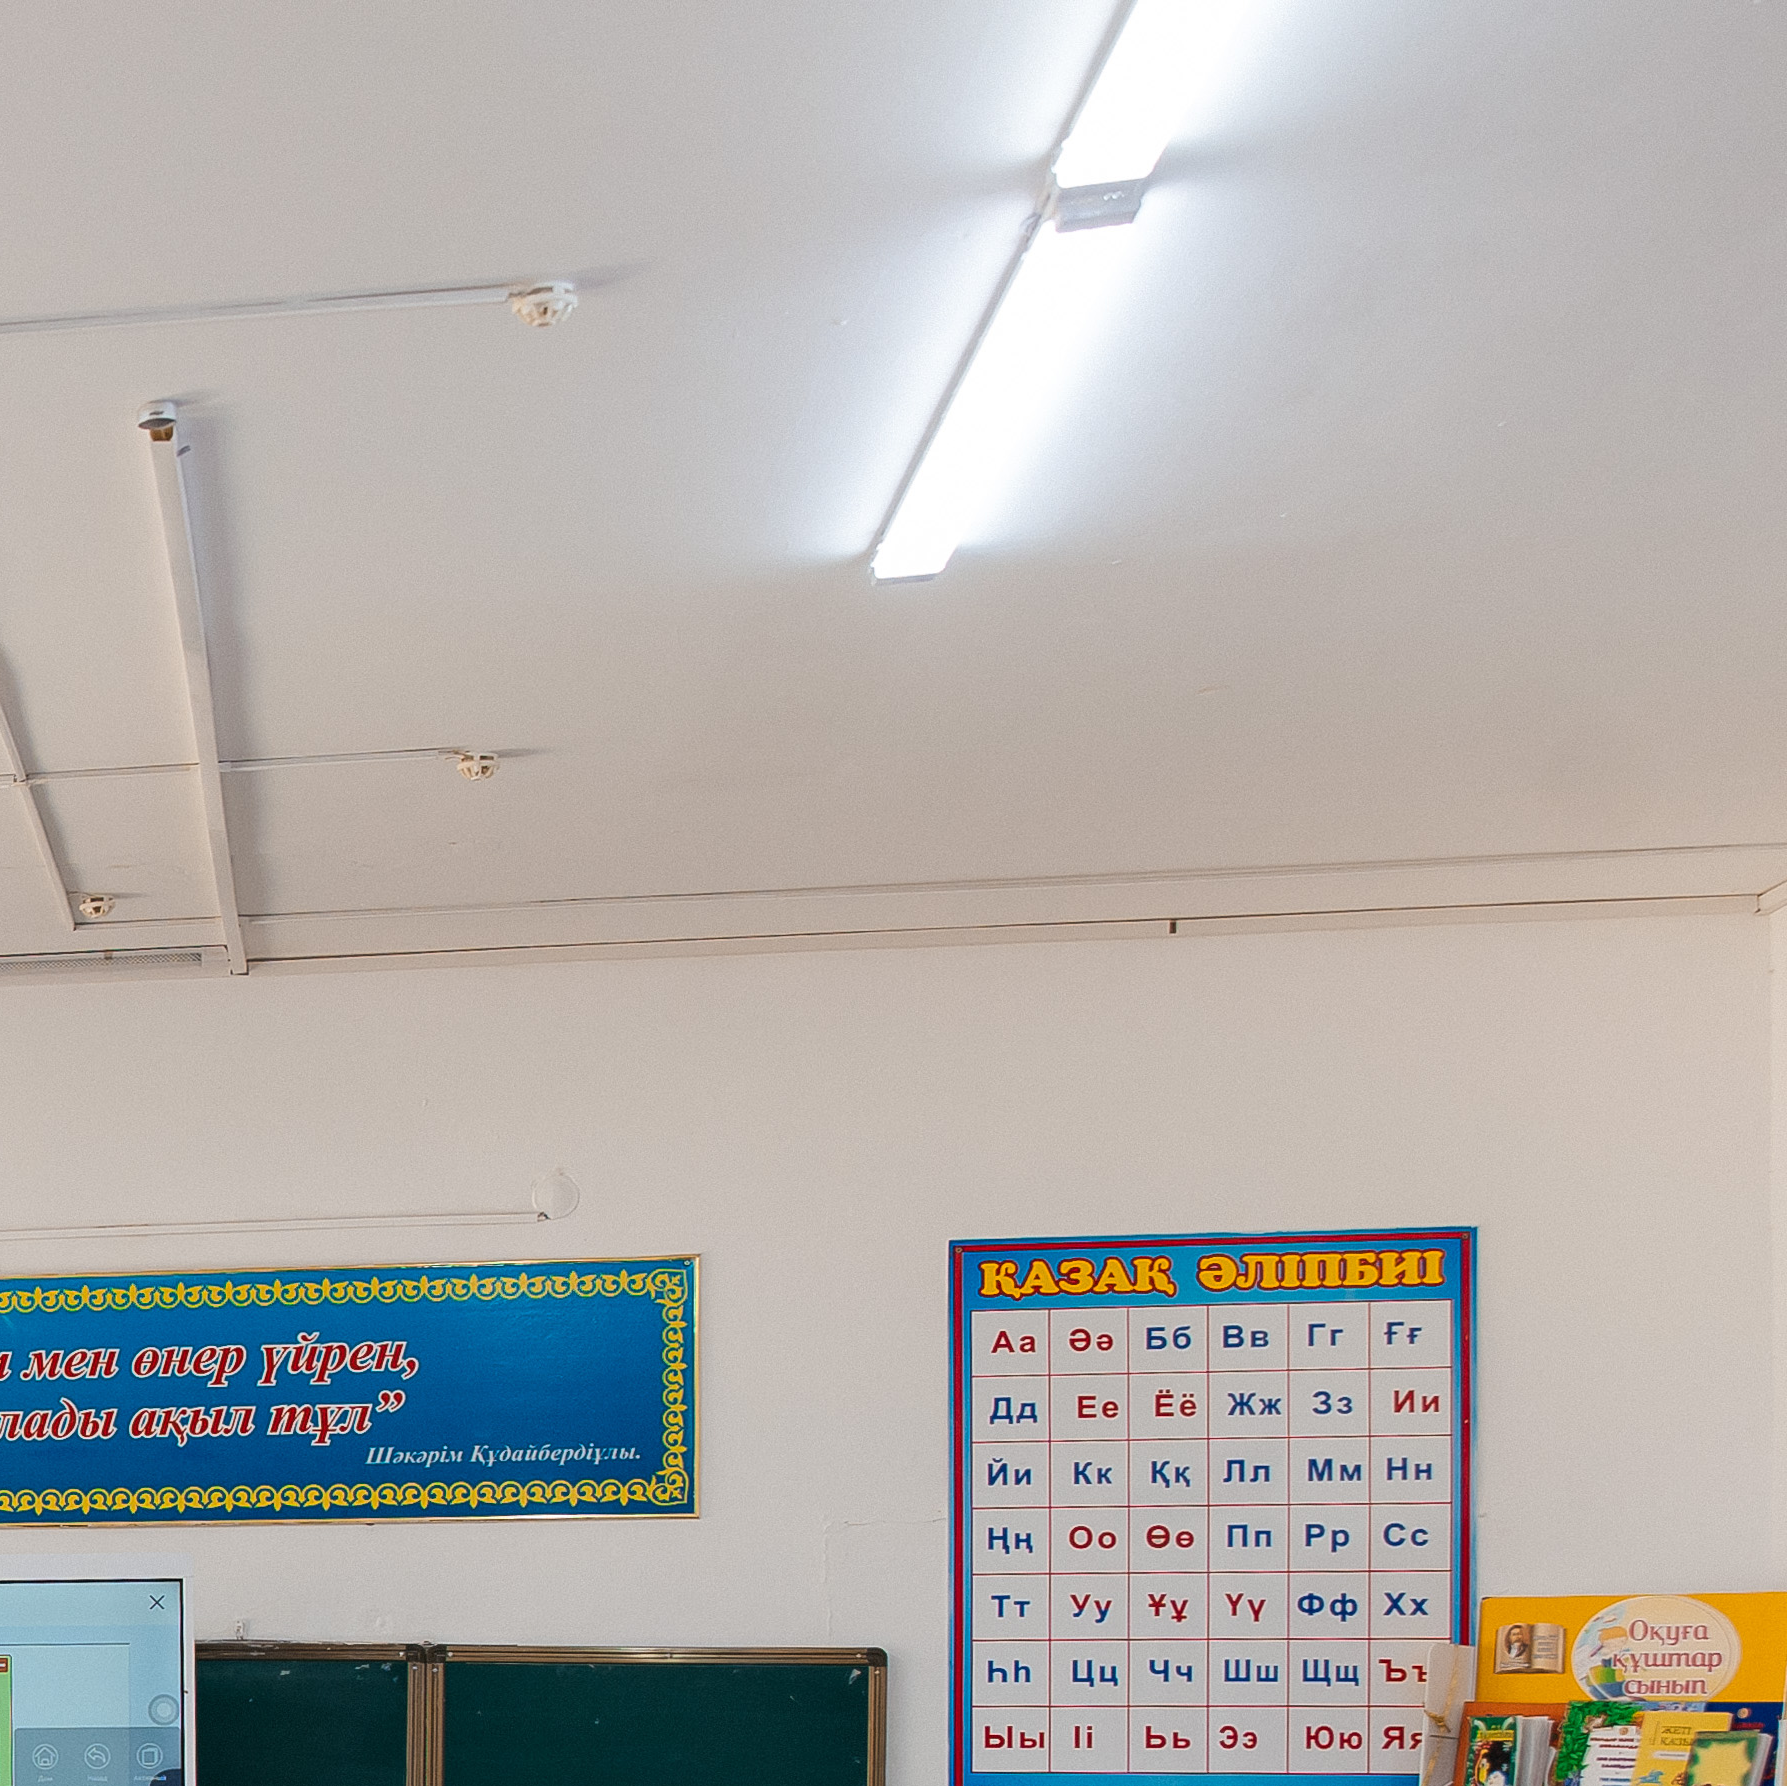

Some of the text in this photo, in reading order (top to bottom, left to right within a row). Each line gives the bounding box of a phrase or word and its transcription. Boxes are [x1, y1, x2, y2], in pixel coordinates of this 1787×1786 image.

[979, 1248, 1444, 1300] ҚАЗАҚ ӘЛІПБИІ
[991, 1321, 1423, 1354] Аа Әә Бб Вв Гг Ғғ
[21, 1346, 118, 1380] мен
[133, 1339, 246, 1387] өнер
[260, 1333, 419, 1387] үйрен,
[129, 1402, 254, 1446] ақыл
[267, 1391, 407, 1446] тұл”
[989, 1388, 1440, 1424] Дд Ее Ёё Жж Зз Ии
[364, 1444, 464, 1468] Шәкәрім
[1073, 1462, 1113, 1485] Кк
[1150, 1460, 1191, 1489] Ққ
[1223, 1459, 1271, 1484] Лл
[1308, 1459, 1362, 1482] Мм
[1386, 1457, 1433, 1481] Нн
[987, 1522, 1429, 1554] Ңң Оо Өө Пп Рр Сс
[991, 1592, 1429, 1623] Тт Уу Ұұ Үү Фф Хх
[1629, 1620, 1709, 1646] Оқуға
[988, 1660, 1031, 1684] Һһ
[1072, 1660, 1119, 1687] Цц
[1149, 1659, 1193, 1683] Чч
[1224, 1659, 1279, 1683] Шш
[1301, 1659, 1360, 1687] Щщ
[1612, 1650, 1722, 1672] құштар
[1624, 1678, 1708, 1696] сынып
[984, 1726, 1045, 1750] Ыы
[1145, 1726, 1191, 1750] Ьь
[1219, 1726, 1258, 1750] Ээ
[1305, 1726, 1364, 1750] Юю
